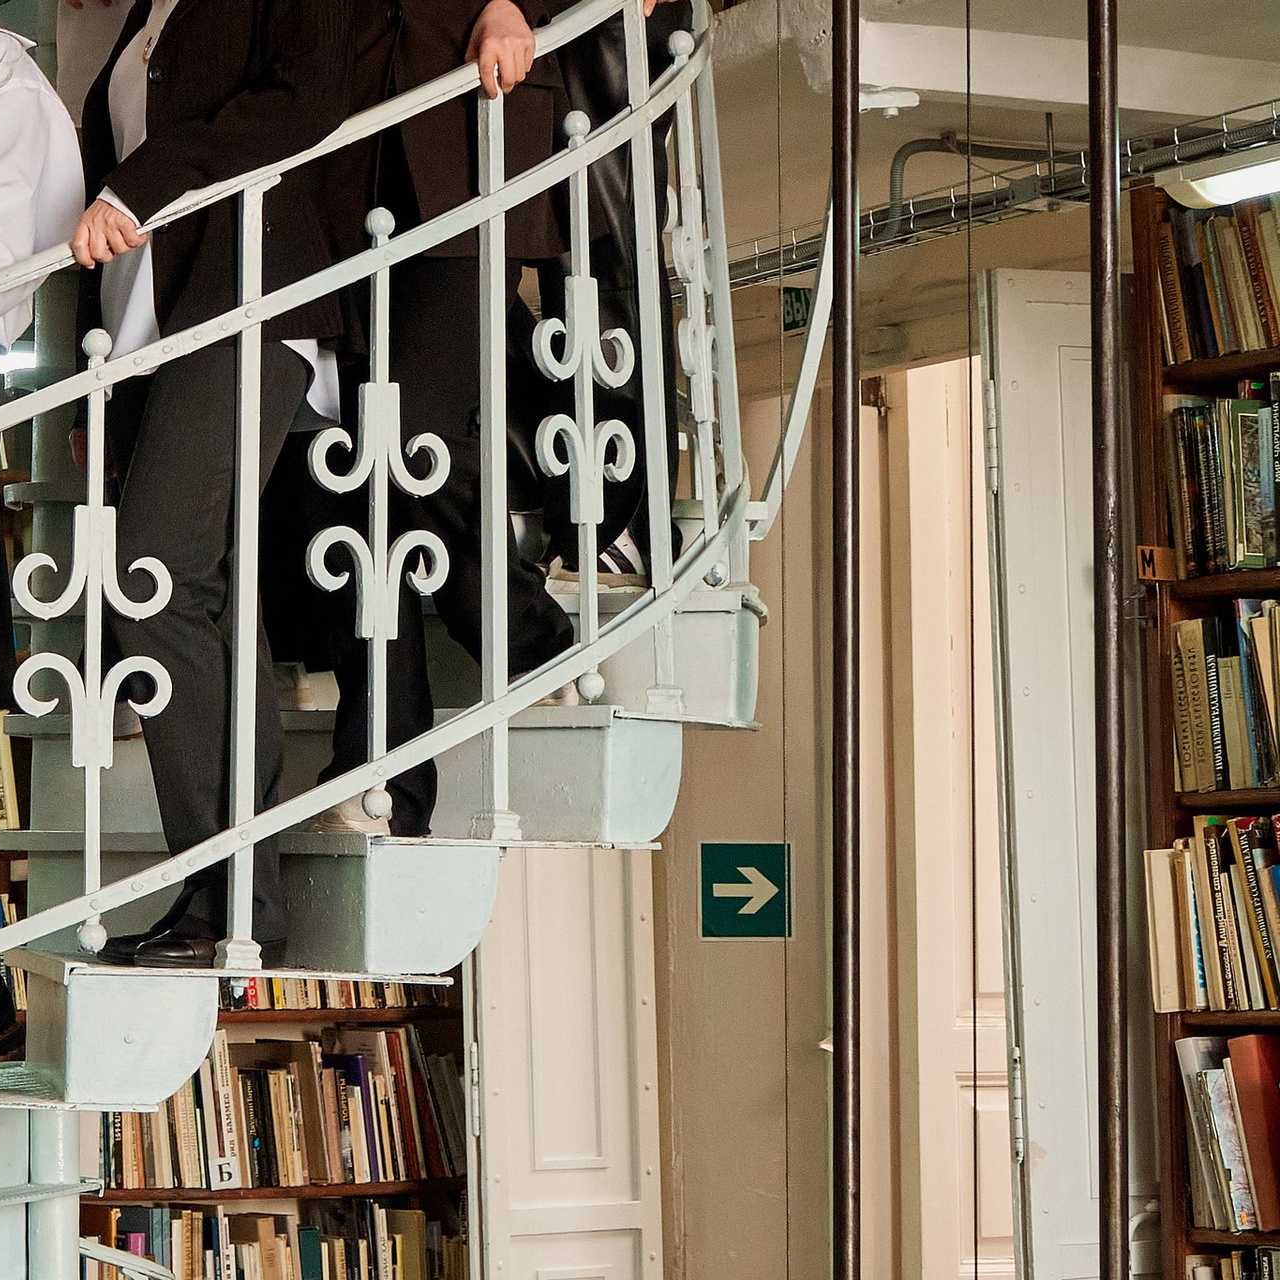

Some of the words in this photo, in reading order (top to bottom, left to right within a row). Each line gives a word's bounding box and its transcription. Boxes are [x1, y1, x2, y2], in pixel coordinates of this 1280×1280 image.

[1140, 548, 1157, 576] М
[1205, 653, 1223, 770] ПОСТИМПРЕССИОНИЗМ
[1238, 831, 1254, 865] ТЕАТРА
[1245, 866, 1261, 903] РУССКОГО
[1252, 904, 1273, 960] ХУДОЖНИКИ
[223, 1092, 234, 1134] БАММЕС
[339, 1077, 349, 1121] ПОРТРЕТЫ
[228, 1140, 237, 1157] рид
[217, 1161, 232, 1183] Б
